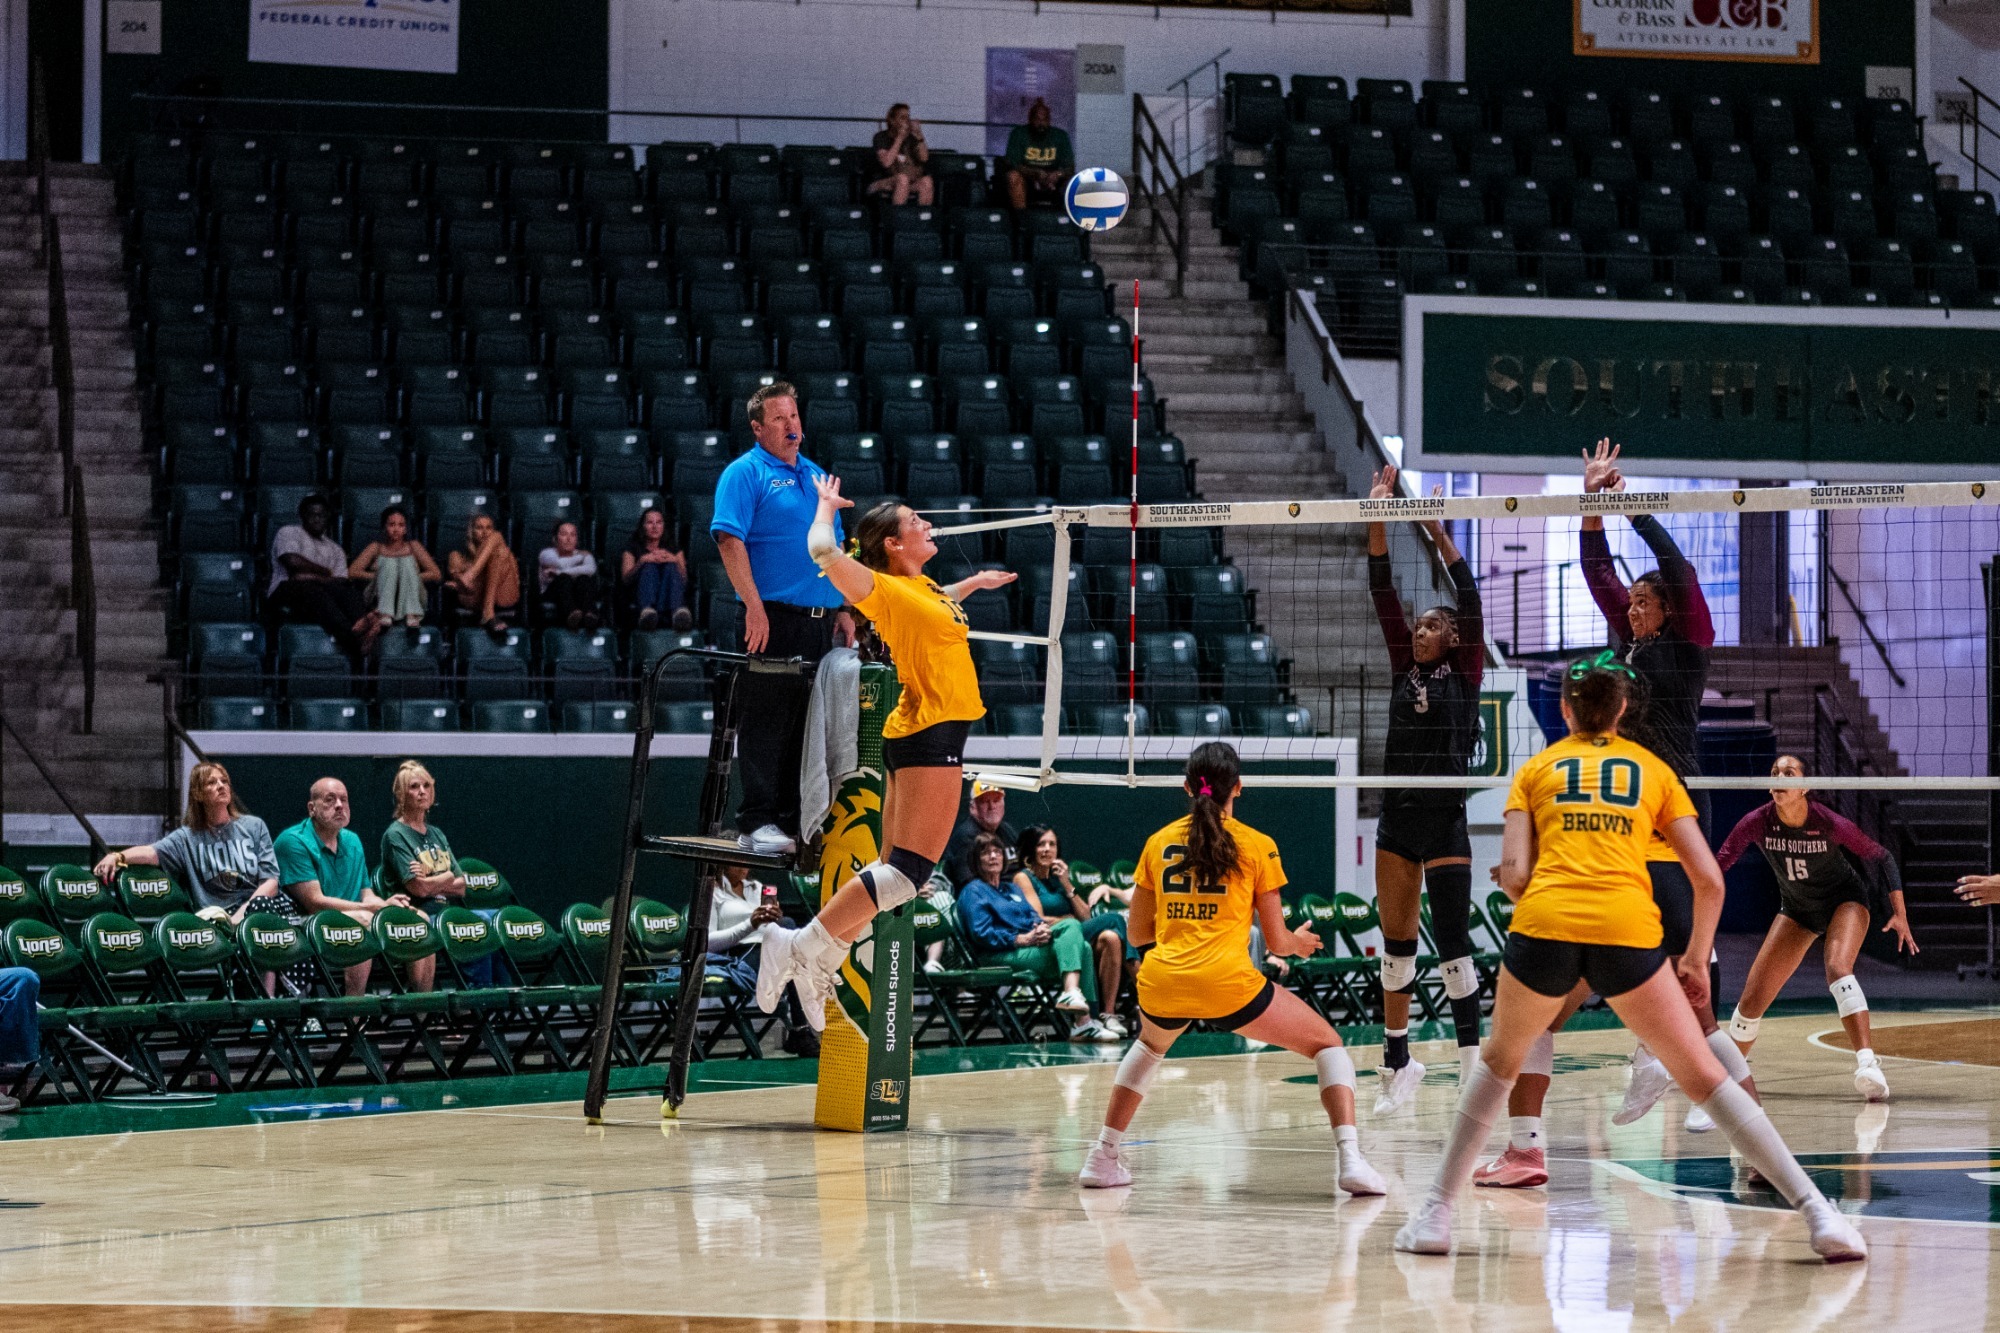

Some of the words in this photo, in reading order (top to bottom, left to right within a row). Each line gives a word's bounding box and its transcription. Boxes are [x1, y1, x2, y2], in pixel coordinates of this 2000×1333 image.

[121, 21, 148, 33] 204
[259, 11, 331, 26] FEDERAL
[337, 15, 395, 30] CREDIT
[399, 20, 450, 33] UNION
[1617, 32, 1711, 45] ATTORNEYS
[1720, 36, 1736, 46] AT
[1747, 37, 1776, 48] LAW
[1083, 63, 1117, 75] 203A
[1878, 86, 1900, 98] 203
[1025, 147, 1057, 161] SLU
[1579, 492, 1669, 504] SOUTHEASTERN
[1810, 485, 1905, 497] SOUTHEASTERN
[1359, 498, 1445, 510] SOUTHEASTERN
[1579, 503, 1621, 511] LOUISIANA
[1622, 502, 1669, 511] UNIVERSITY
[1810, 497, 1854, 505] LOUISIANA
[1856, 495, 1905, 504] UNIVERSITY
[1150, 504, 1231, 516] SOUTHEASTERN
[1359, 509, 1399, 518] LOUISIANA
[1400, 508, 1445, 517] UNIVERSITY
[1150, 515, 1187, 523] LOUISIANA
[1554, 757, 1642, 809] 10
[1563, 812, 1635, 836] BROWN
[1787, 839, 1828, 854] SOUTHERN
[198, 838, 258, 882] LIONS
[1785, 857, 1809, 881] 15
[1166, 902, 1218, 920] SHARP
[889, 941, 900, 989] sports
[886, 992, 897, 1052] imports
[870, 1079, 905, 1104] SLU
